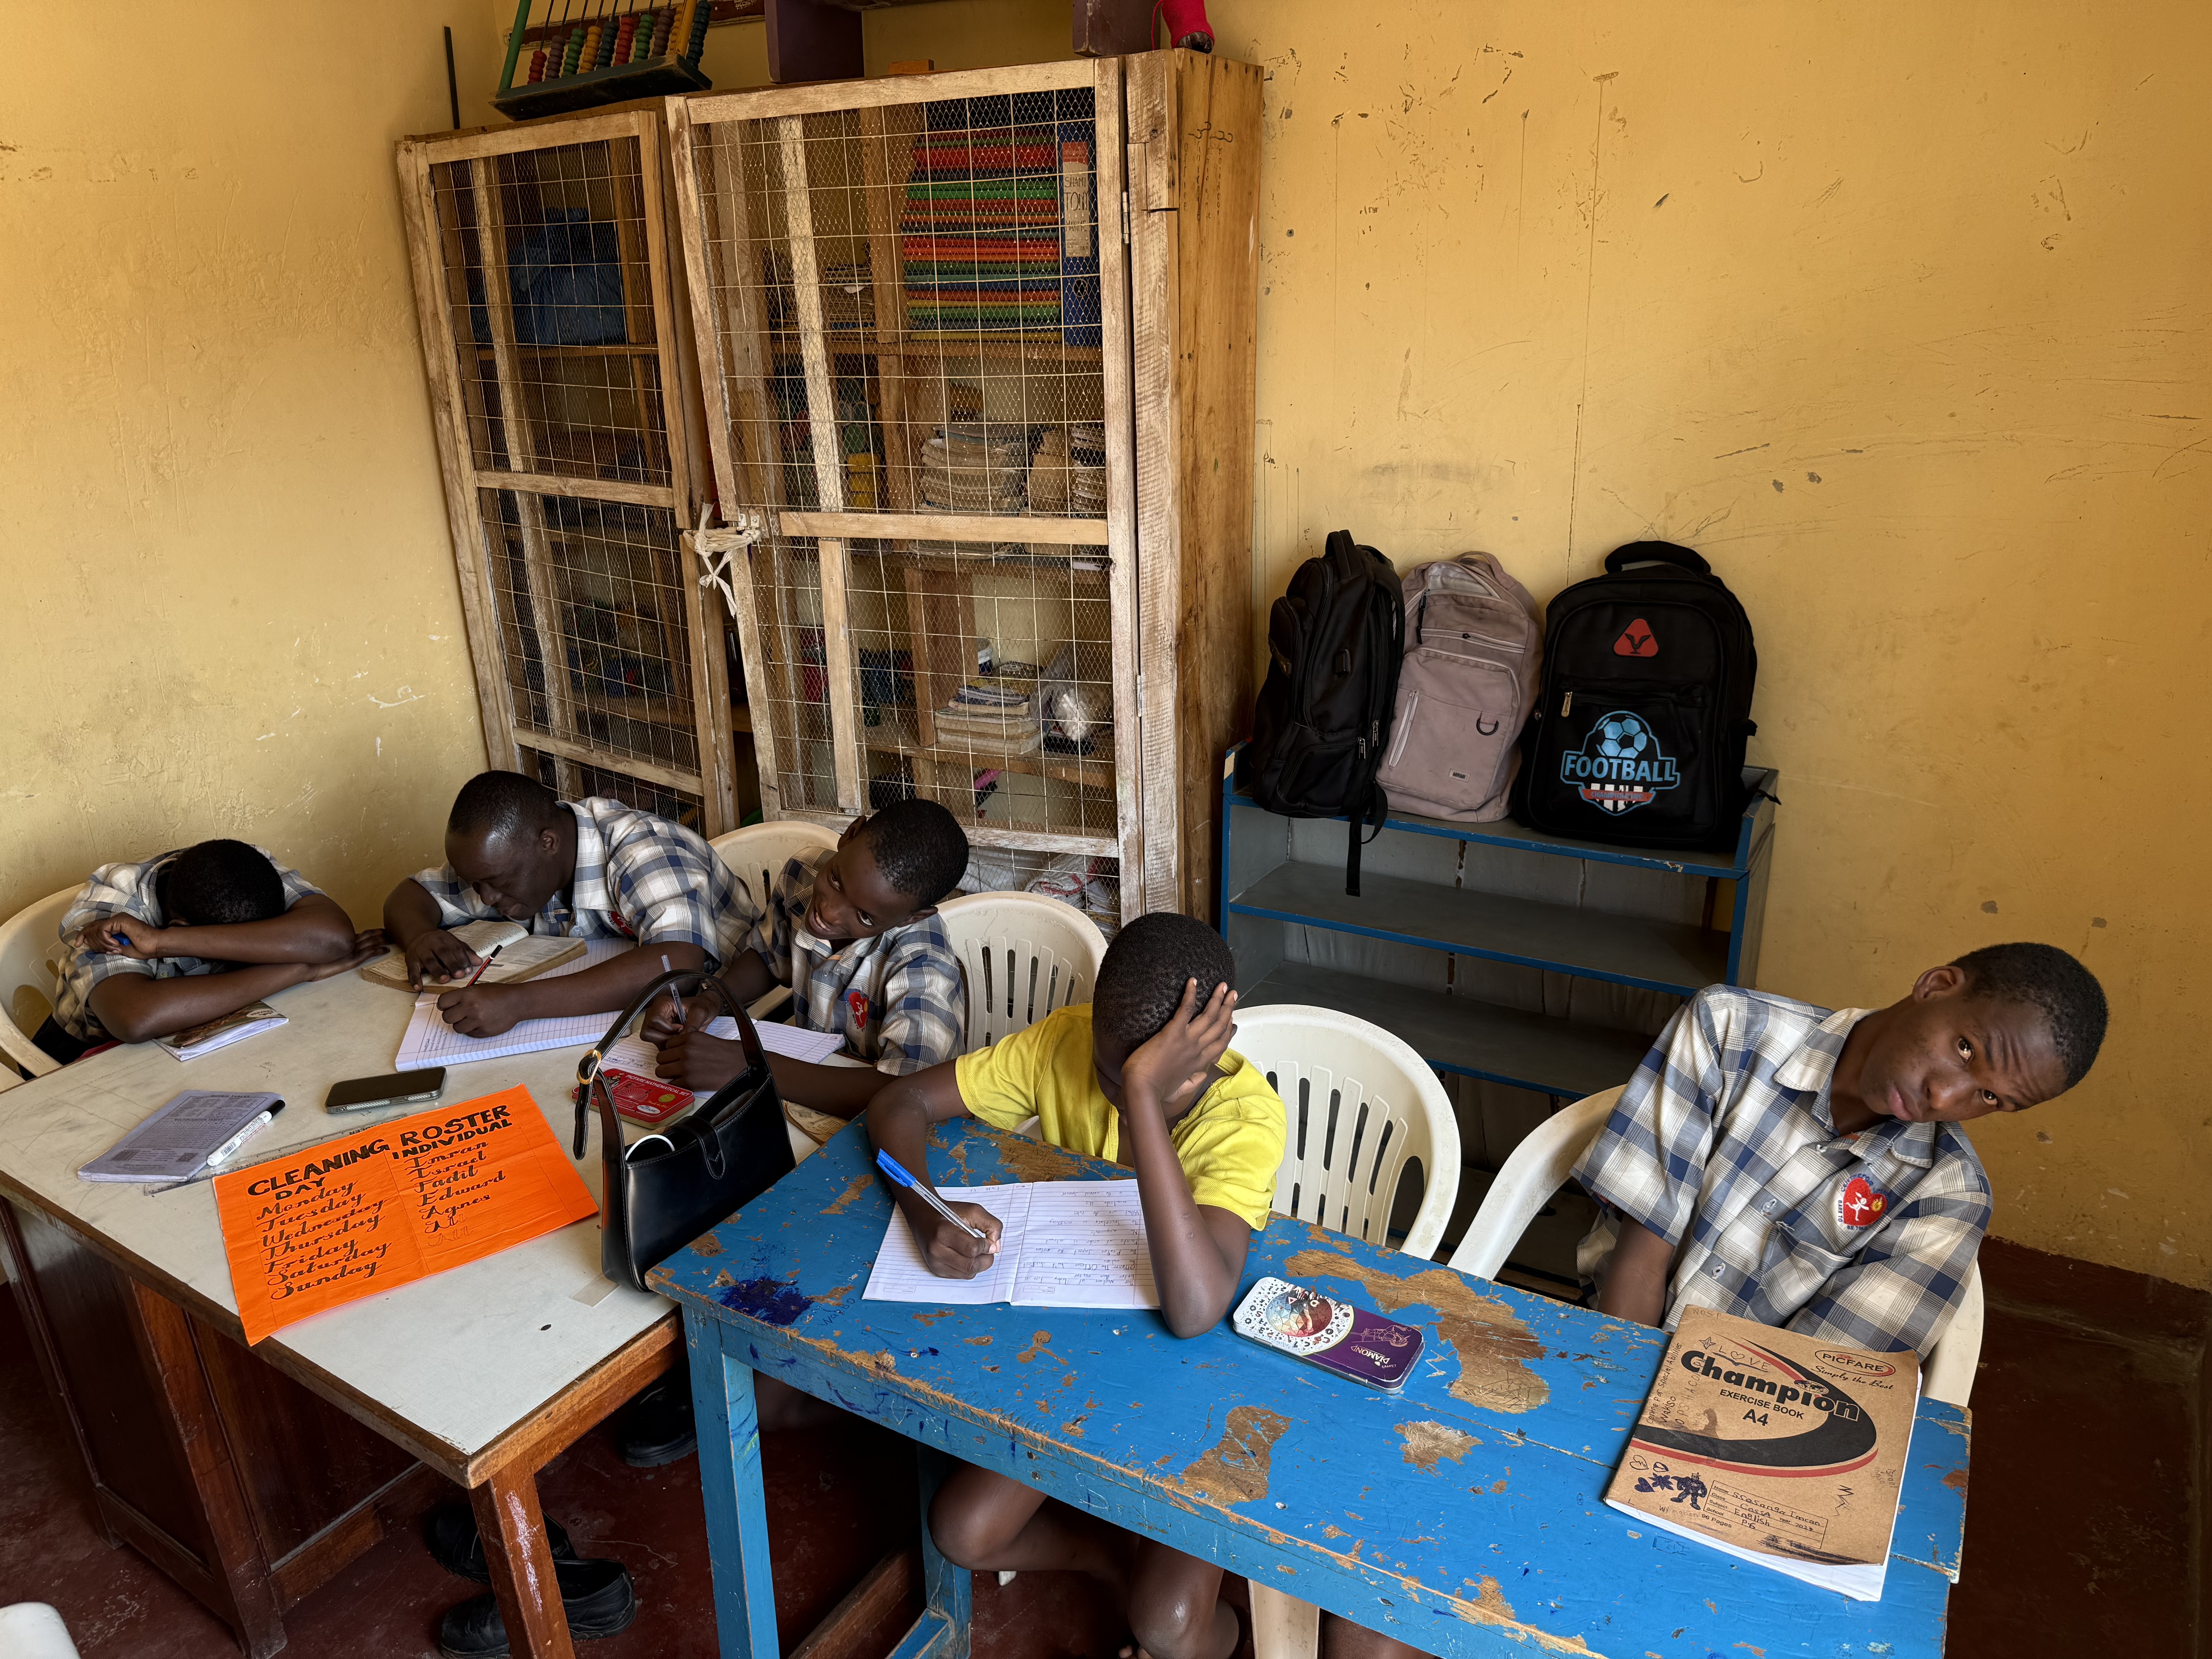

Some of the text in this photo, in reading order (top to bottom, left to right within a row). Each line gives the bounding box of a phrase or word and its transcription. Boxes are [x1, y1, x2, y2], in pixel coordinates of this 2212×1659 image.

[1065, 177, 1086, 187] SHAMI
[1565, 756, 1675, 782] FOOTBALL
[626, 1075, 646, 1083] PICFARE
[645, 1080, 679, 1094] MATHEMATICAL
[247, 1105, 511, 1196] CLEANING ROSTER
[275, 1119, 512, 1200] DAY INDIVIDUAL
[255, 1151, 486, 1232] Tuesday Israel
[257, 1142, 489, 1220] Monday Imran
[261, 1170, 506, 1260] Thursday Edward
[261, 1199, 390, 1247] Wednesday
[264, 1194, 491, 1274] Friday Agnes
[267, 1213, 467, 1286] Saturday All
[271, 1261, 382, 1300] Sunday
[1351, 1345, 1390, 1364] DIAMOND
[1822, 1353, 1884, 1372] PICFARE
[1681, 1350, 1860, 1421] Champion
[1811, 1365, 1848, 1381] Simply
[1869, 1380, 1894, 1389] Best
[1719, 1389, 1805, 1420] EXERCISE BOOK
[1742, 1409, 1769, 1426] A4
[1714, 1486, 1729, 1494] Name
[1707, 1507, 1724, 1516] School
[1709, 1500, 1728, 1509] Subject
[1734, 1508, 1770, 1526] English
[1711, 1517, 1732, 1528] Pages
[1790, 1511, 1820, 1526] Imran
